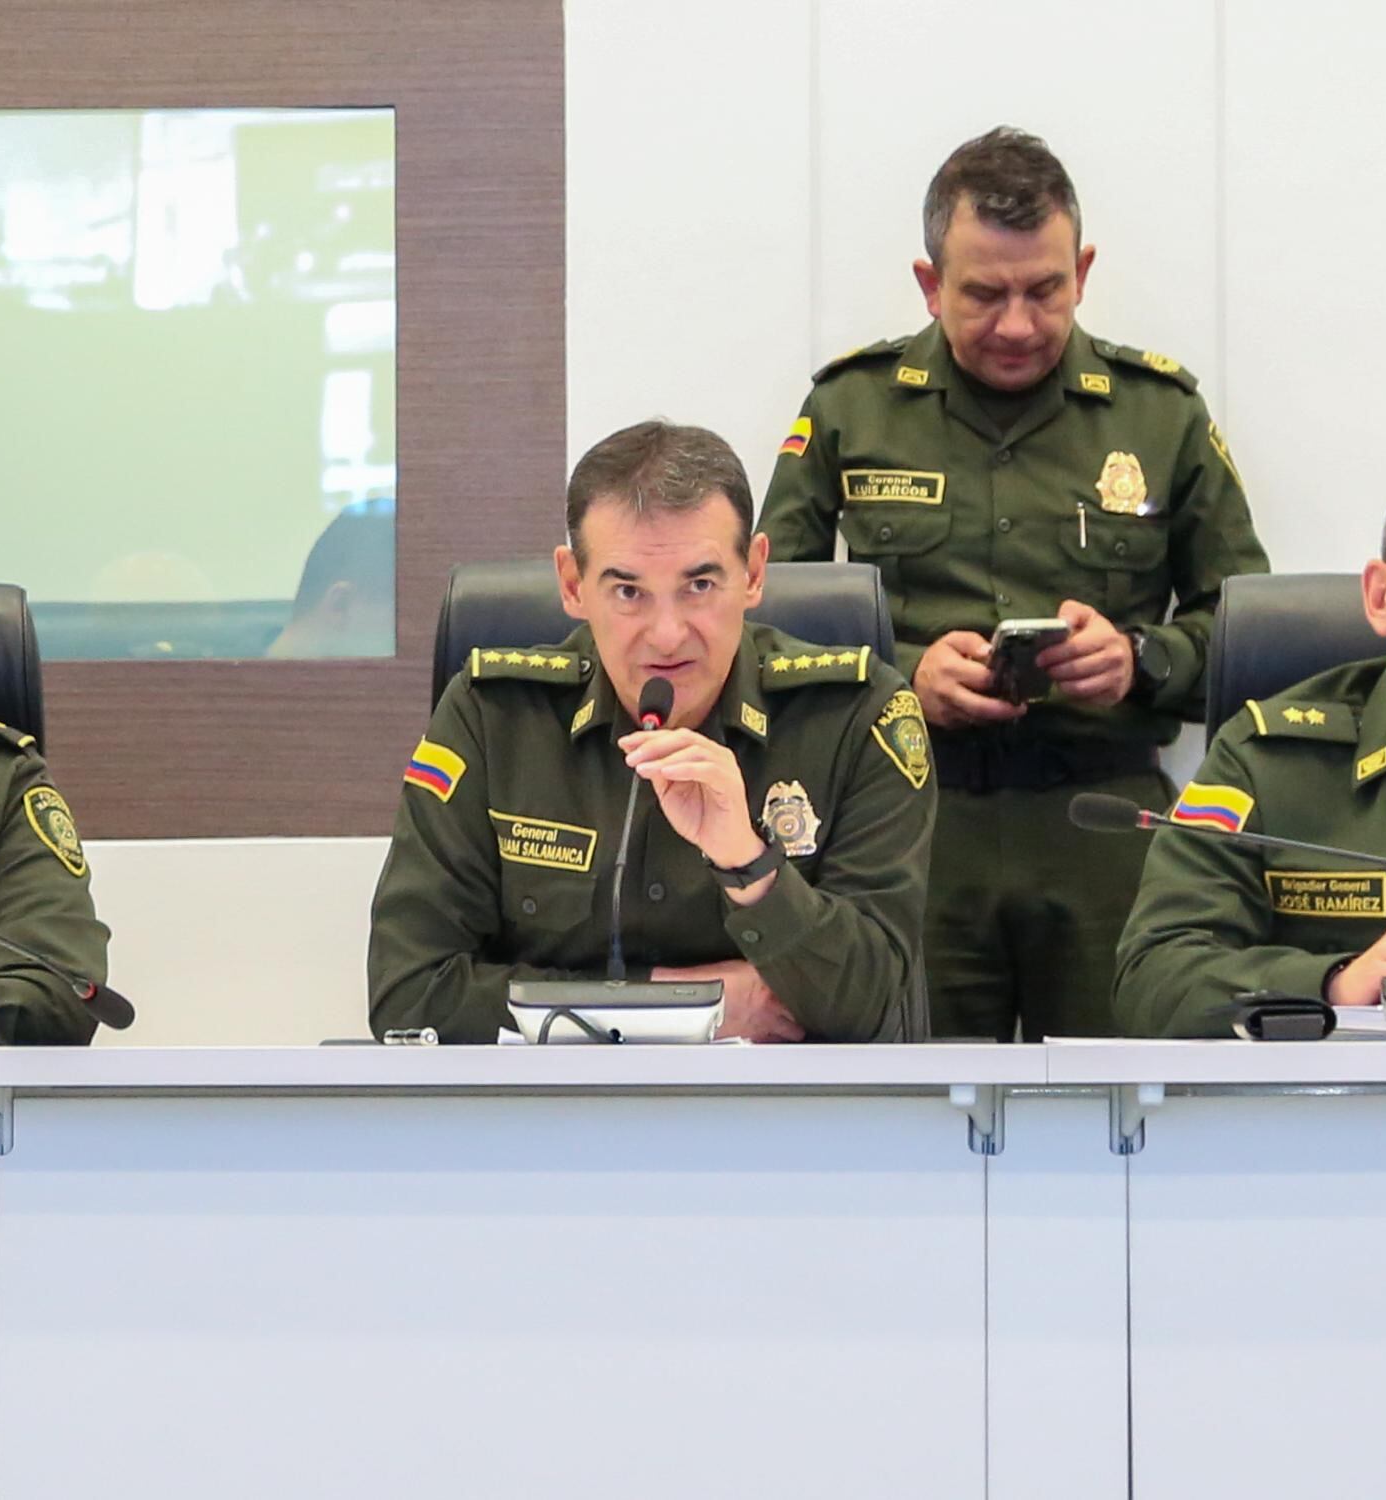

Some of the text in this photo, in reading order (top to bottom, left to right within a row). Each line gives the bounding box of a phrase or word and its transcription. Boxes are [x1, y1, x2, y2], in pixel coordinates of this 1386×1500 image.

[868, 475, 912, 485] Coronel
[855, 485, 879, 496] LUIS
[512, 822, 558, 842] General
[522, 841, 583, 864] SALAMANCA
[1315, 893, 1381, 911] RAMÍREZ
